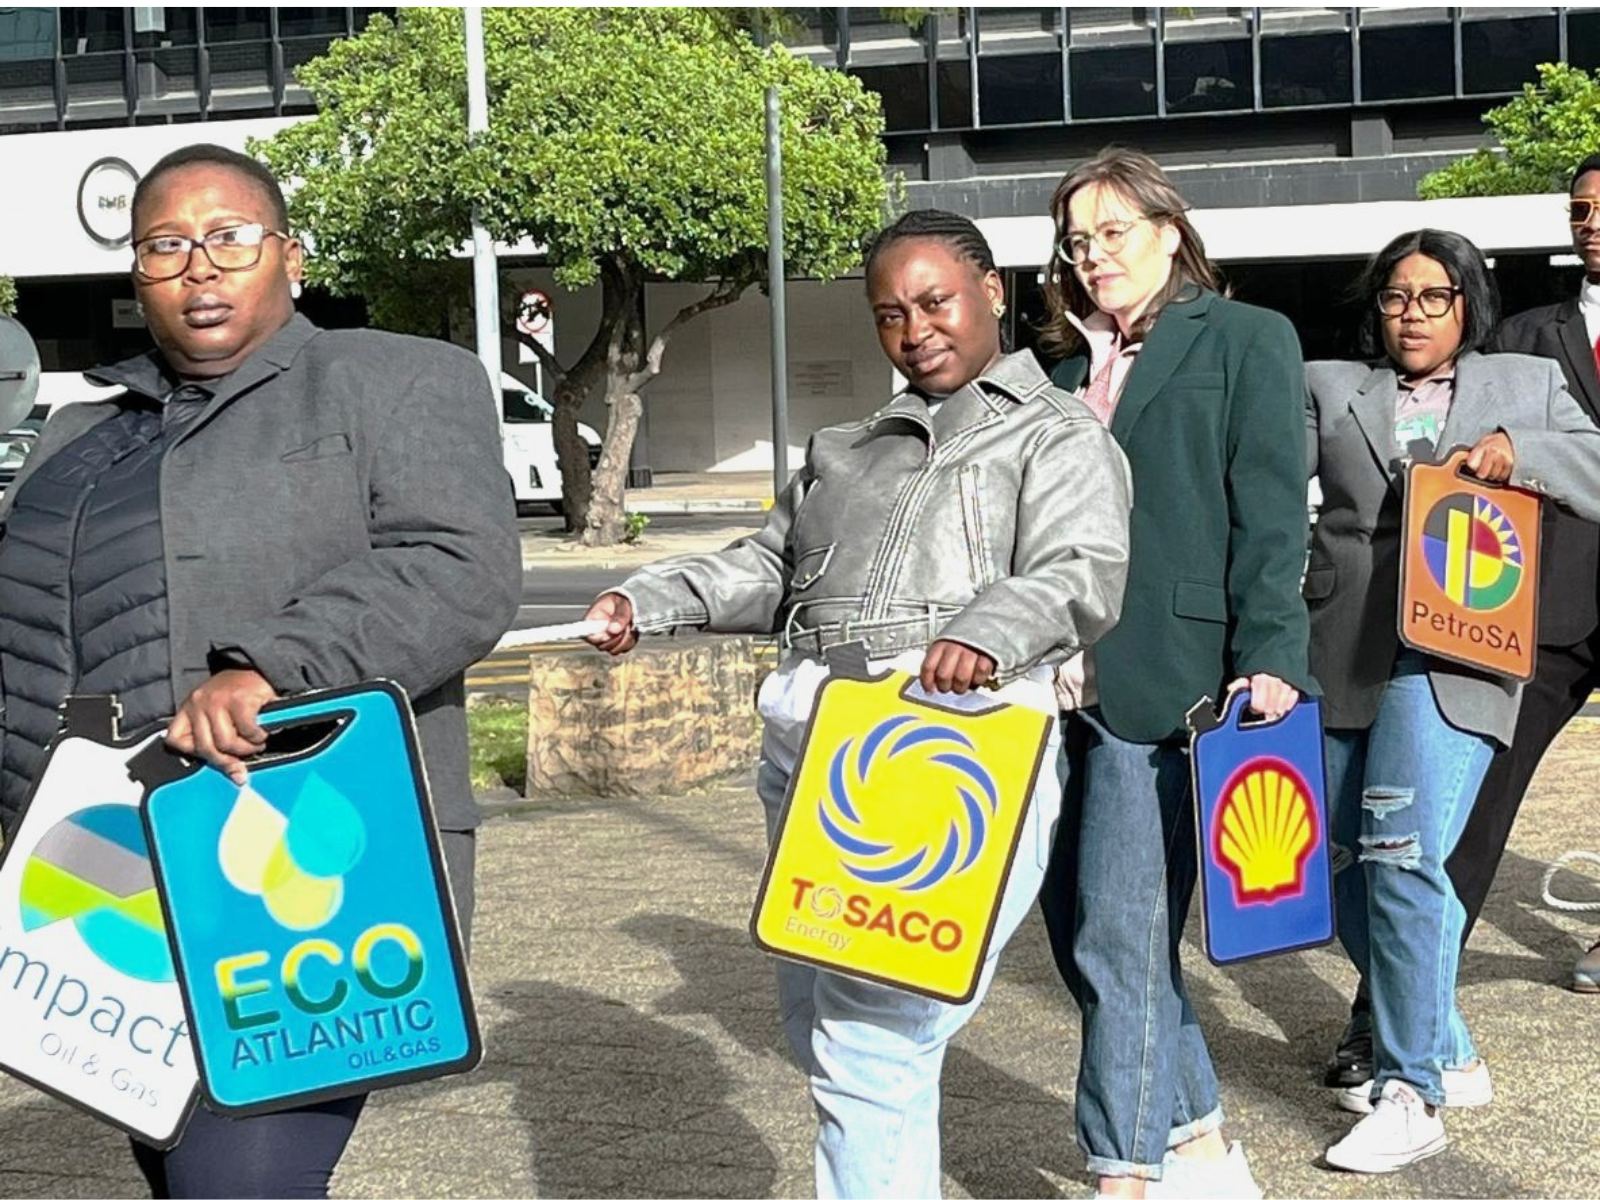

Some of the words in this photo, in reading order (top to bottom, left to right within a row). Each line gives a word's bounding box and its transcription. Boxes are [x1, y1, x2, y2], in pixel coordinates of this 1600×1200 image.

[1411, 601, 1522, 656] PetroSA
[784, 915, 852, 951] Energy
[791, 877, 963, 952] TOSACO
[0, 946, 188, 1067] mpact
[215, 924, 423, 1030] ECO
[40, 1032, 78, 1065] Oil
[81, 1053, 101, 1076] &
[111, 1067, 159, 1108] Gas
[232, 999, 434, 1070] ATLANTIC
